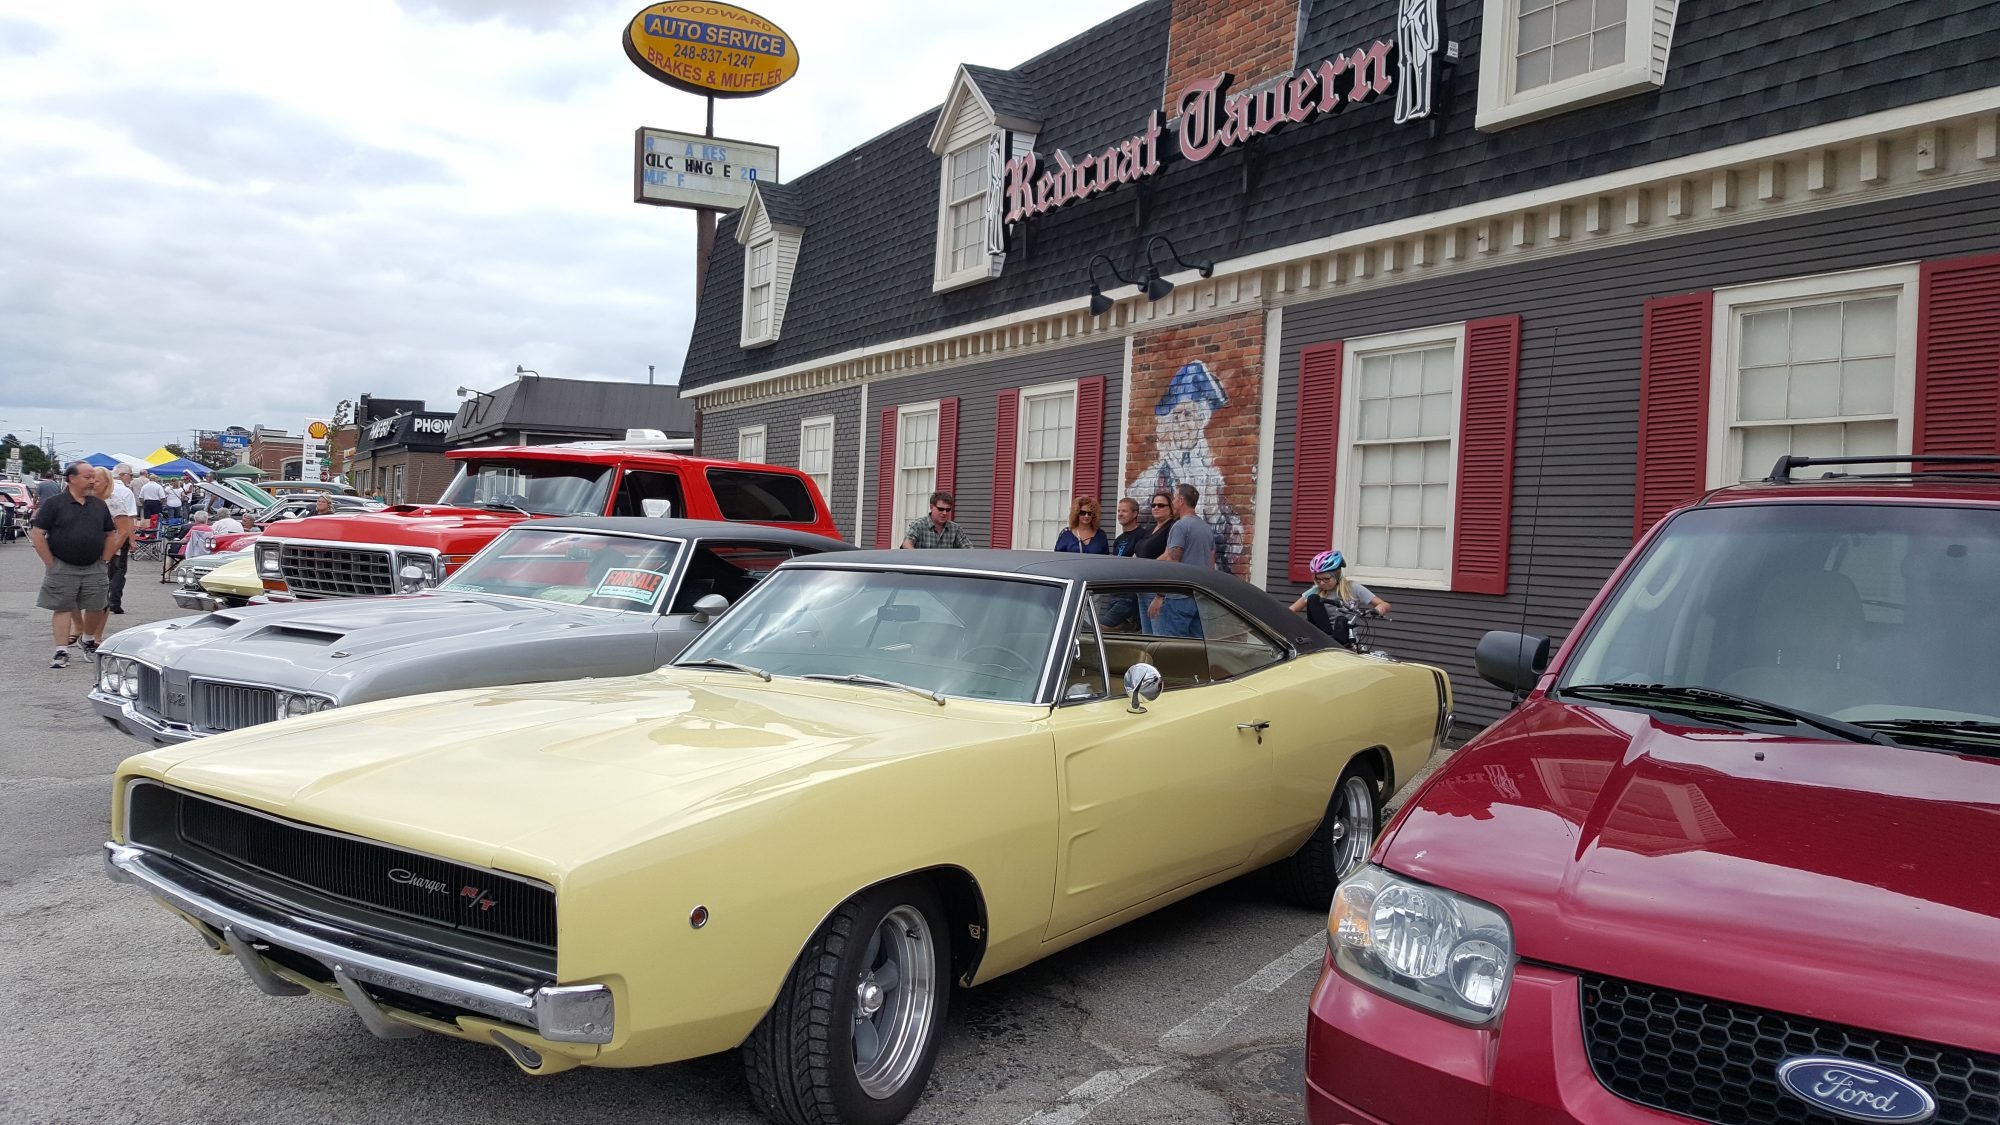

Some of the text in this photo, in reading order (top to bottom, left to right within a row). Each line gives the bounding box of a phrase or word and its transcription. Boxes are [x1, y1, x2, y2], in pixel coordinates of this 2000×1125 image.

[650, 18, 782, 54] AUTO SERVICE
[662, 5, 771, 32] WOODWARD
[647, 46, 782, 88] BRAKES & MUFFLER
[673, 43, 756, 69] 248-837-1247
[1005, 39, 1394, 224] Redcoat Tavern
[606, 571, 629, 586] FOR
[629, 572, 661, 592] SALE
[388, 868, 498, 911] Charger R/T
[1813, 1069, 1899, 1112] Ford
